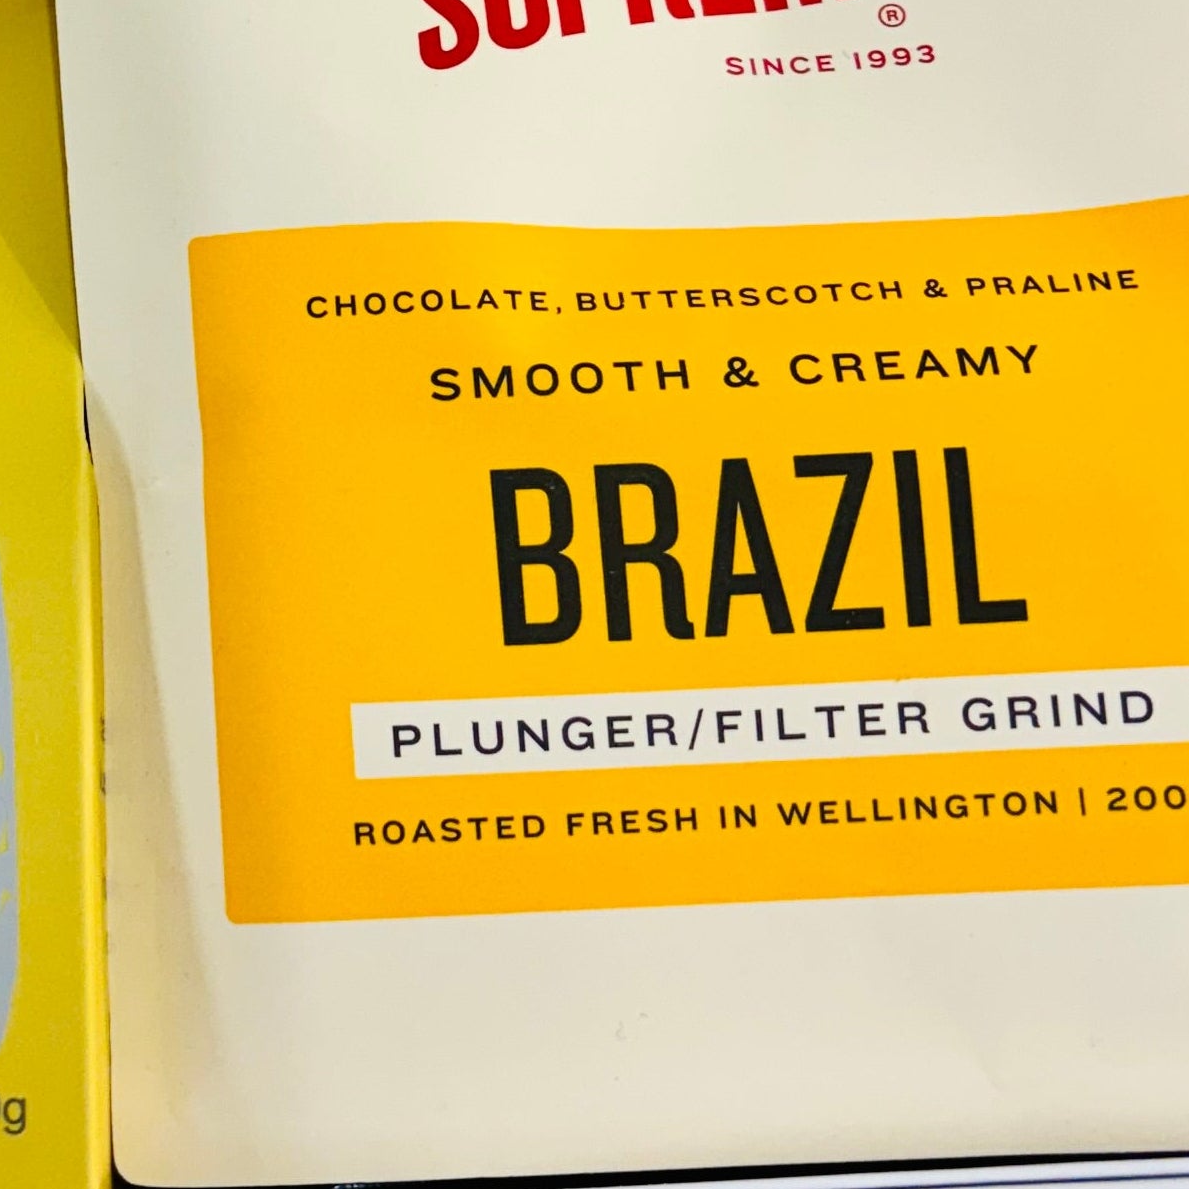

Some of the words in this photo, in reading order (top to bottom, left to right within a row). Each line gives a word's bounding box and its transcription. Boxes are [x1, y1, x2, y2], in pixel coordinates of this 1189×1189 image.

[724, 53, 836, 77] SINCE
[852, 44, 937, 71] 1993
[305, 287, 563, 320] CHOCOLATE,
[574, 279, 904, 314] BUTTERSCOTCH
[923, 278, 949, 299] &
[966, 268, 1140, 297] PRALINE
[428, 357, 692, 402] SMOOTH
[724, 354, 761, 390] &
[788, 343, 1043, 387] CREAMY
[488, 445, 1030, 648] BRAZIL
[391, 700, 933, 760] PLUNGER/FILTER
[961, 689, 1158, 733] GRIND
[352, 814, 547, 847] ROASTED
[565, 806, 700, 838] FRESH
[719, 804, 759, 830] IN
[776, 790, 1059, 829] WELLINGTON
